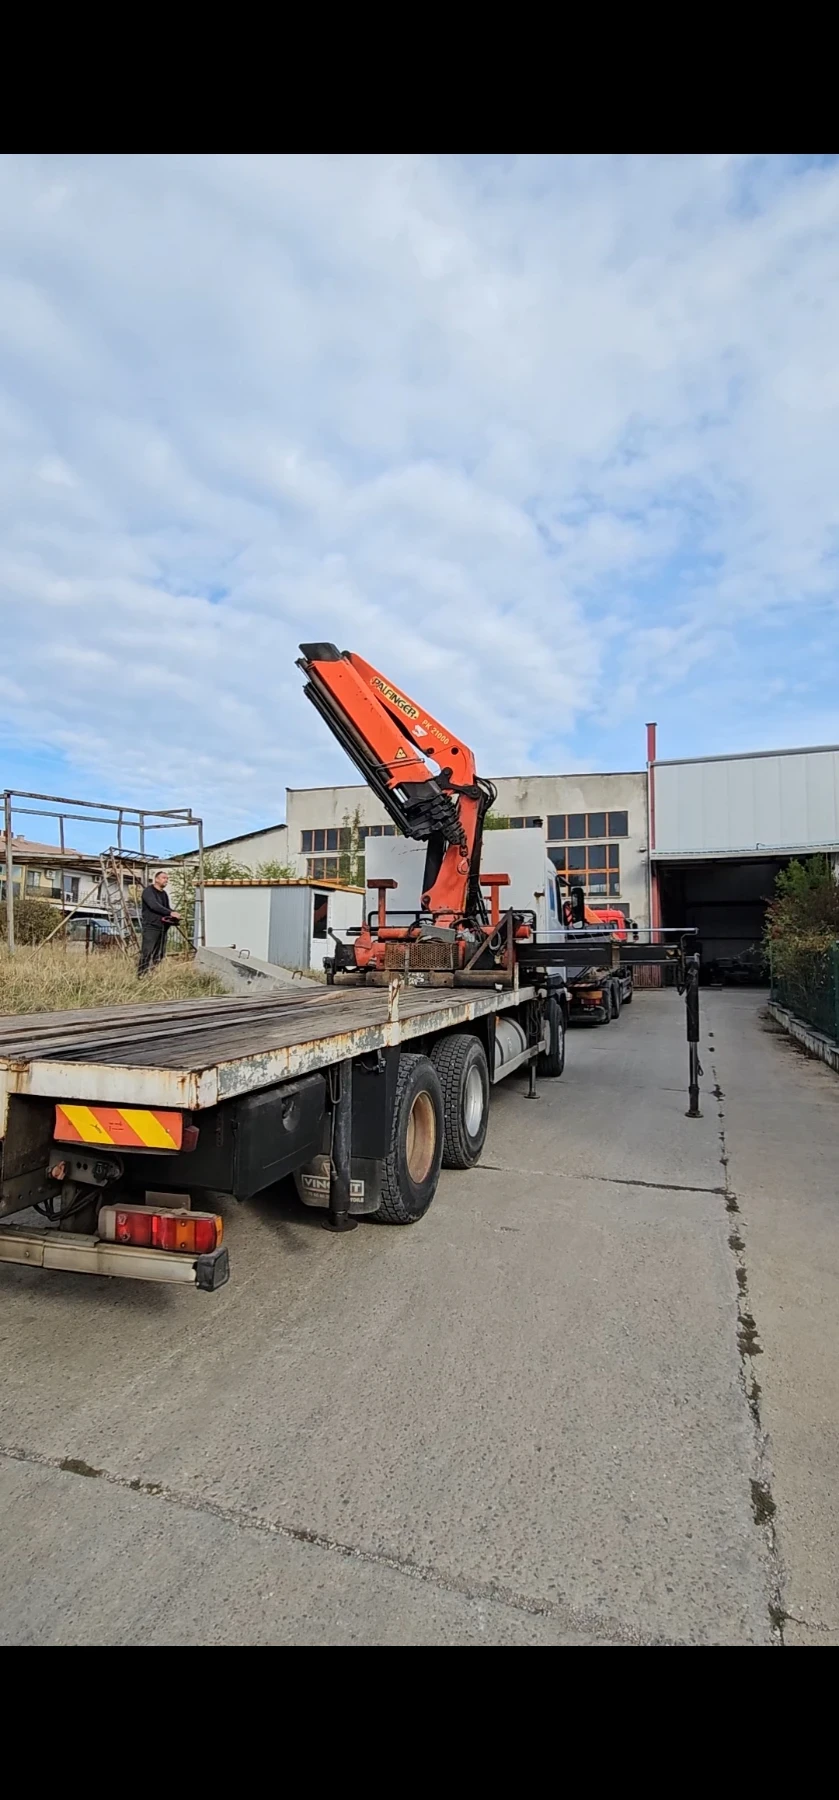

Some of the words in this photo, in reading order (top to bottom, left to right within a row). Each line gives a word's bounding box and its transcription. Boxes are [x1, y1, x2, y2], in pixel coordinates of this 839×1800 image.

[372, 678, 416, 717] PALFINGER
[422, 719, 431, 730] PK
[431, 727, 449, 745] 21000
